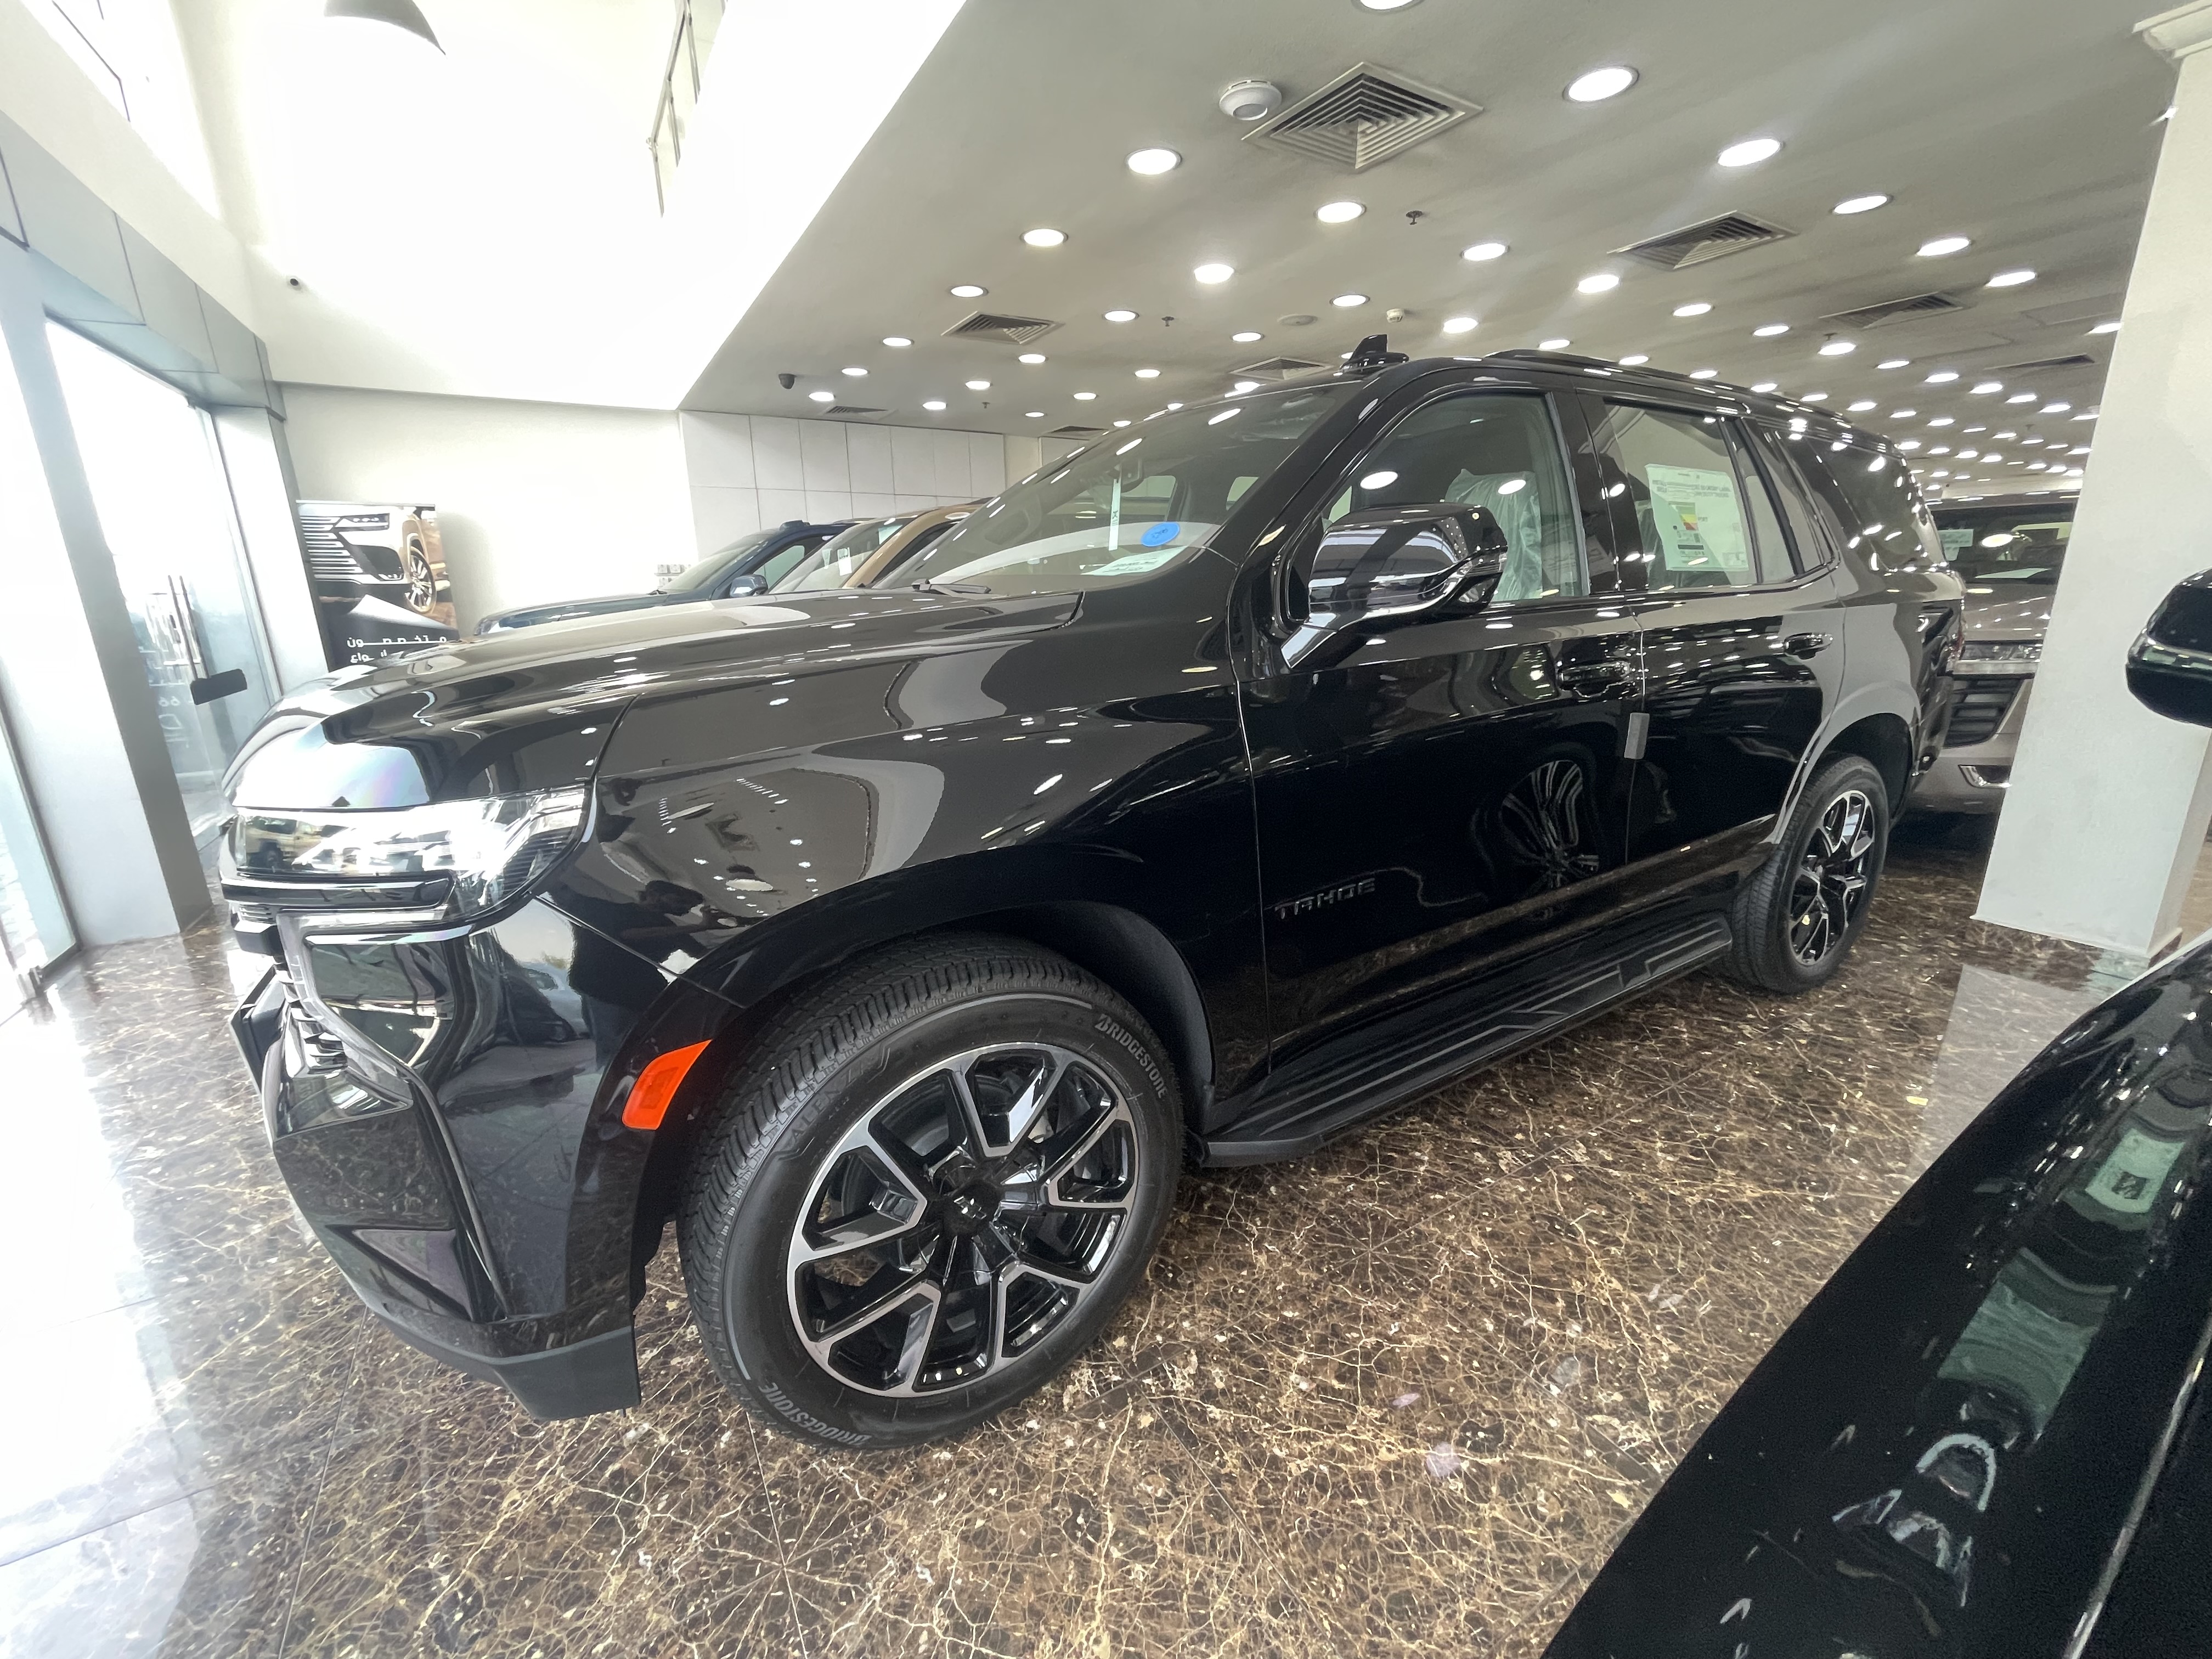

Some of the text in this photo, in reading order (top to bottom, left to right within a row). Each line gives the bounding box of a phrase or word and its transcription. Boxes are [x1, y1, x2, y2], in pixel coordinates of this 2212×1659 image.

[1274, 878, 1375, 919] TAHOE
[1094, 1013, 1169, 1099] BRIDGESTONE
[758, 1381, 872, 1446] BRIDGESTONE
